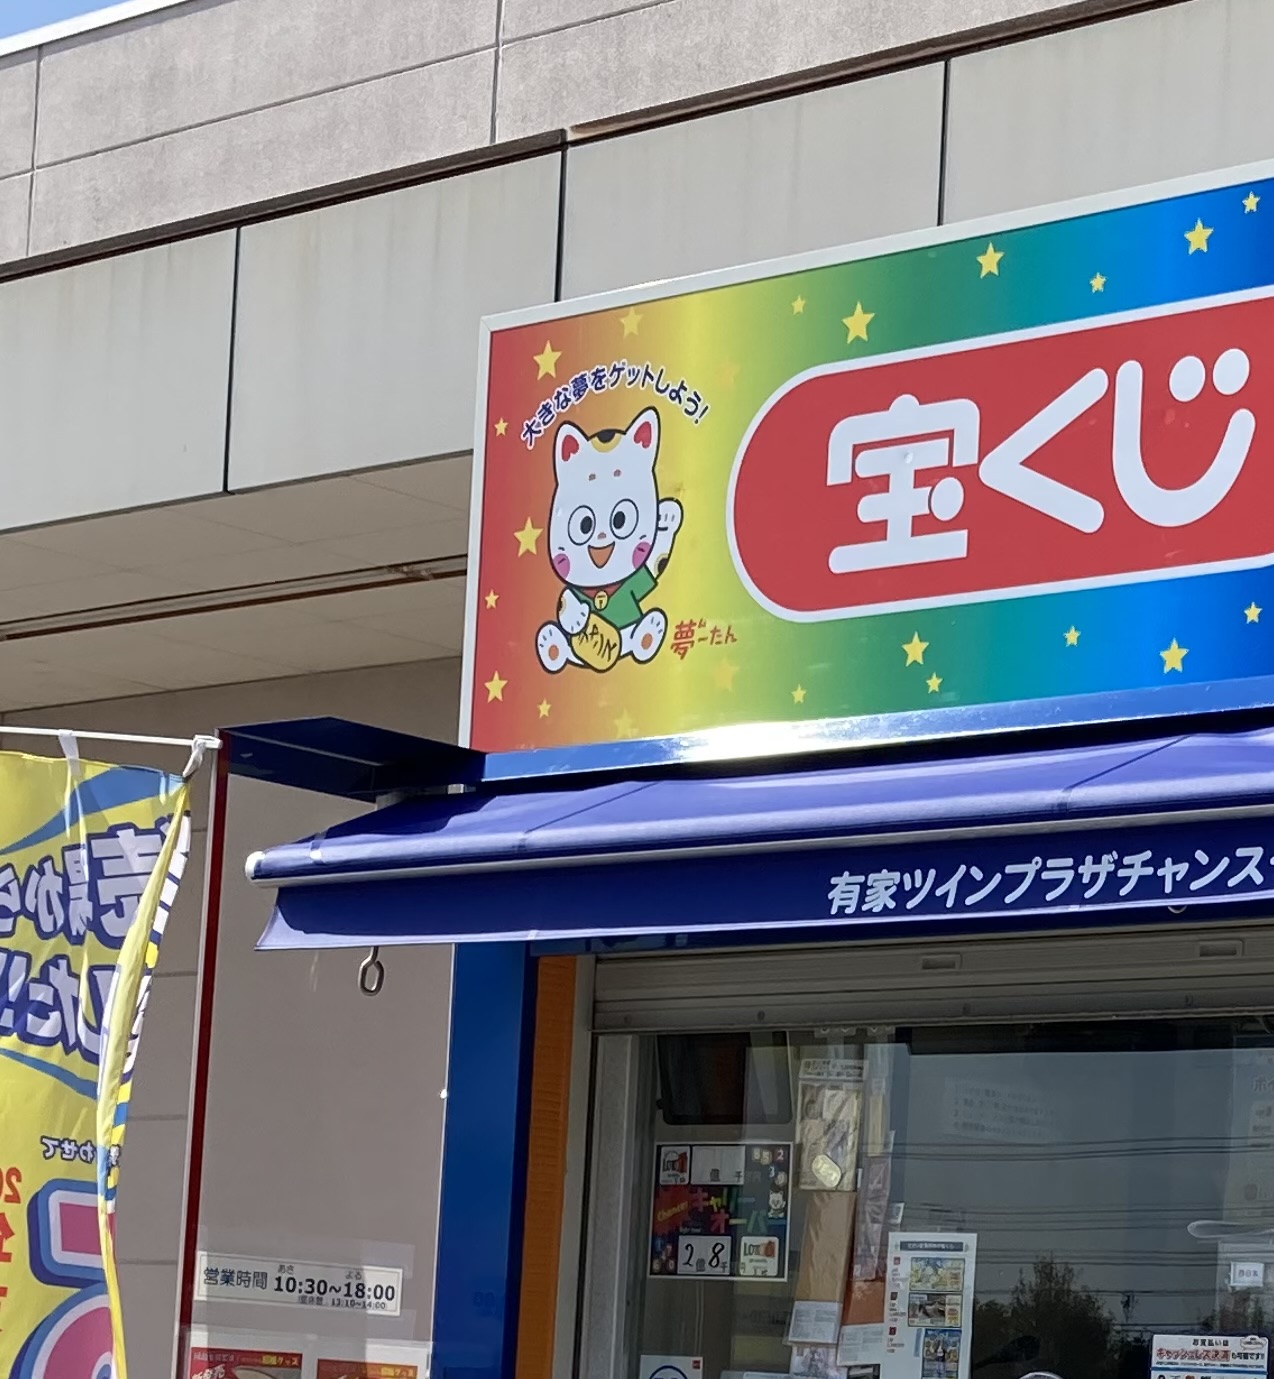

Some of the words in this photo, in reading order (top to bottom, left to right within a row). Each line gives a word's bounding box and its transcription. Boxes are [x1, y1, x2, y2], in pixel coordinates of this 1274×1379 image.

[521, 359, 710, 450] 大きな夢をゲットしよう!
[827, 347, 1256, 575] 宝くじ
[204, 1267, 267, 1290] 営業時間
